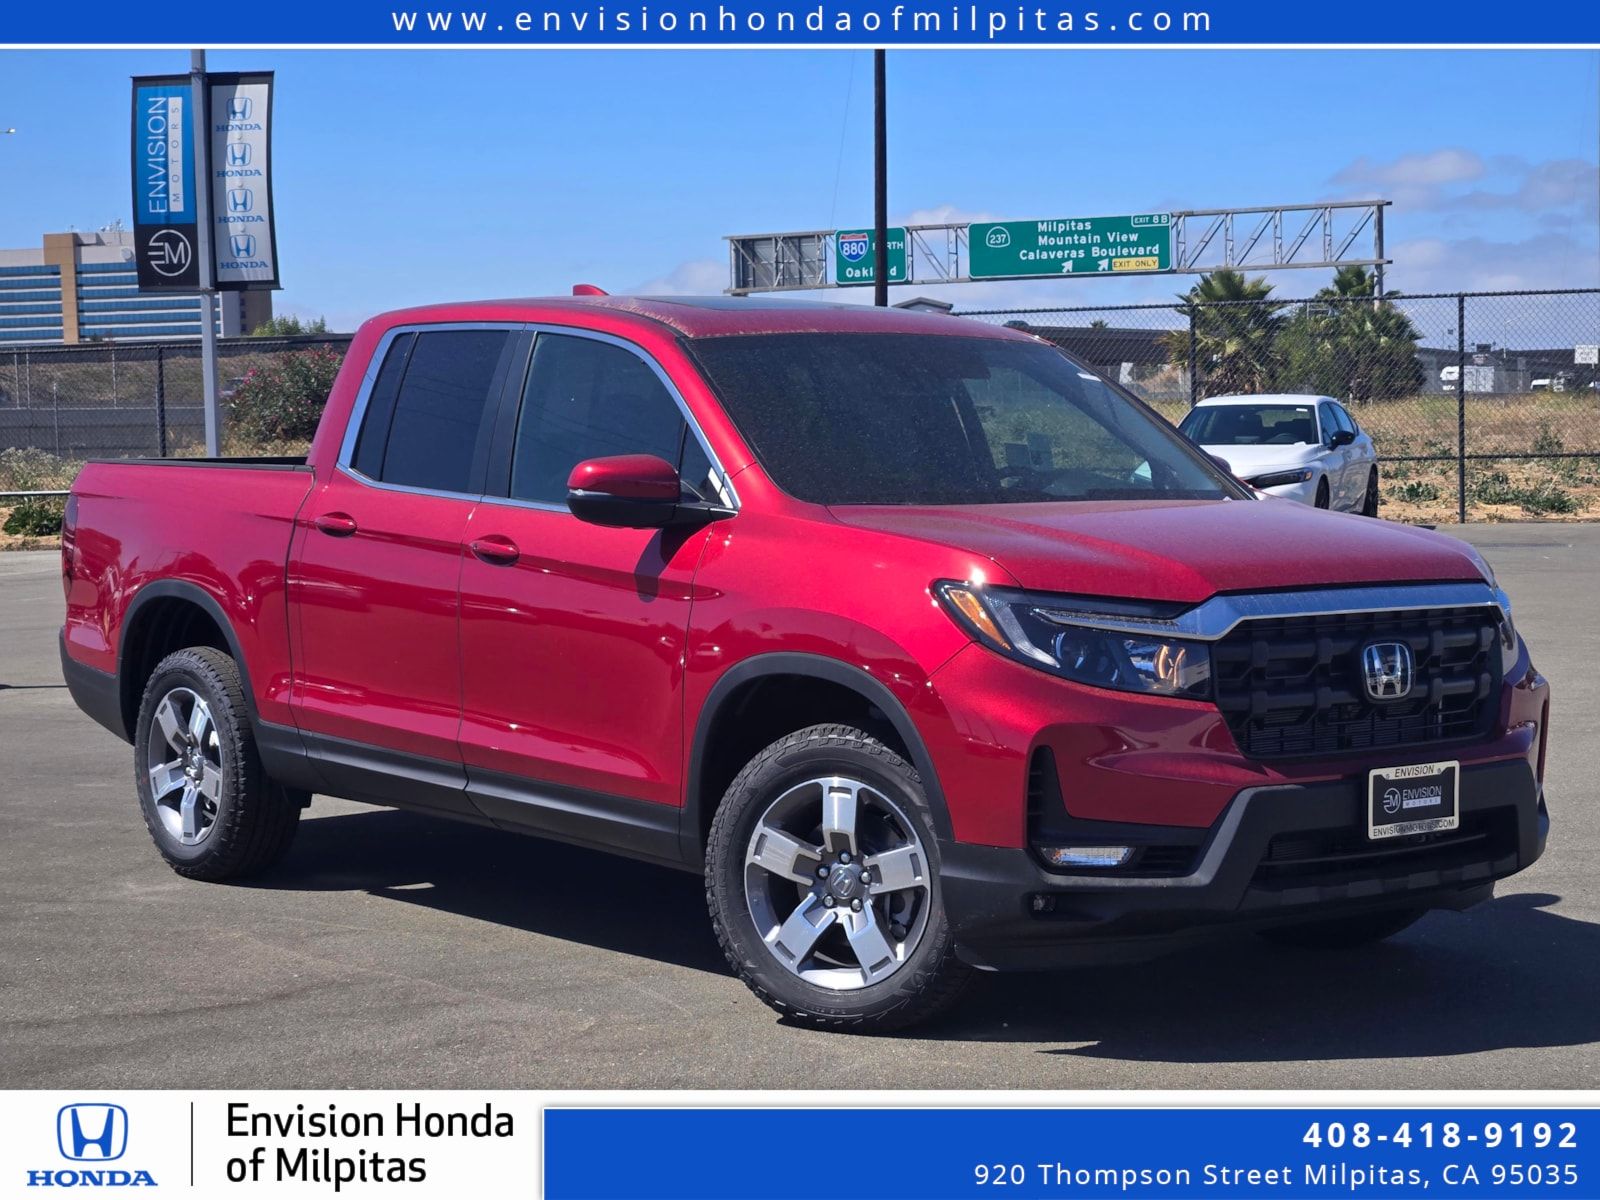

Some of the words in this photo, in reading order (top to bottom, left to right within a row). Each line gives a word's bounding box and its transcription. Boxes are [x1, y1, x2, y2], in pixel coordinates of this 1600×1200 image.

[216, 122, 262, 132] HONDA
[148, 96, 167, 213] ENVISION
[171, 106, 180, 202] MOTORS
[216, 169, 262, 178] HONDA
[218, 215, 265, 224] HONDA
[1037, 221, 1092, 234] Milpitas
[989, 234, 1007, 245] 237
[1038, 234, 1101, 246] Mountain
[1106, 232, 1139, 243] View
[842, 242, 866, 256] 880
[1019, 249, 1085, 261] Calaveras
[1091, 244, 1160, 258] Boulevard
[220, 260, 269, 269] HONDA
[1113, 260, 1132, 268] EXIT
[1135, 259, 1158, 267] ONLY
[845, 265, 897, 278] Oakld
[1394, 764, 1435, 778] ENVISION
[1403, 786, 1441, 800] ENVISION
